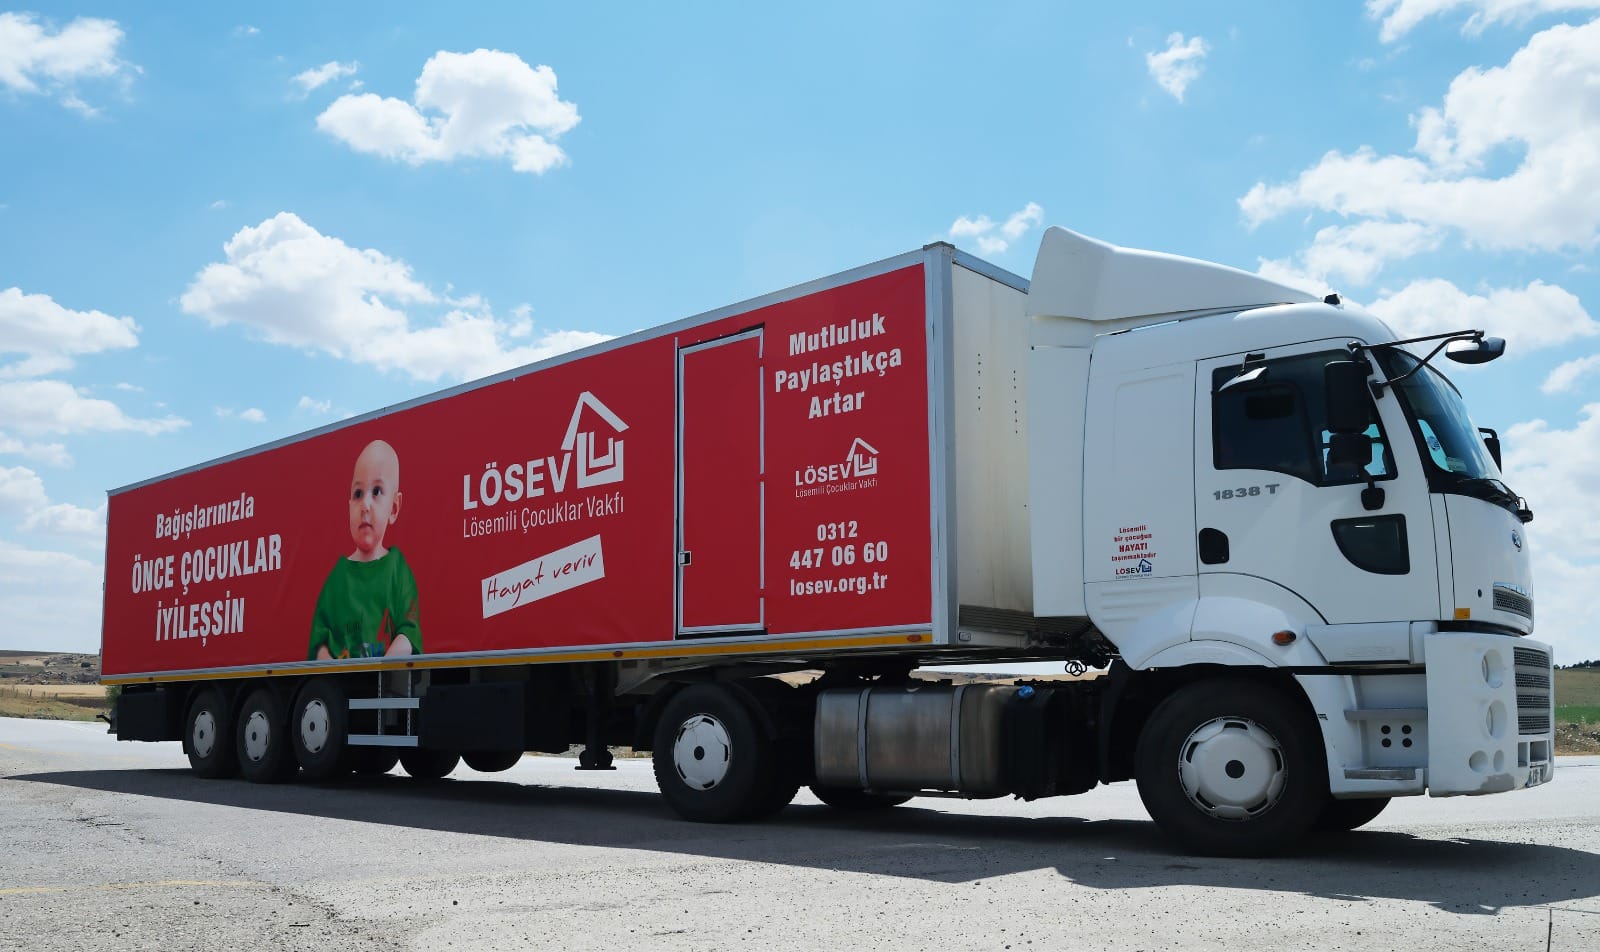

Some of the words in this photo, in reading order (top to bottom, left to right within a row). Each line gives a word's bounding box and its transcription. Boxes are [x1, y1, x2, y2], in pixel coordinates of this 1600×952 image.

[789, 313, 886, 356] Mutluluk
[775, 348, 902, 393] Paylaştıkça
[808, 390, 865, 419] Artar
[463, 452, 572, 510] LÖSEV
[795, 461, 852, 486] LÖSEV
[795, 486, 825, 498] Lösemili
[826, 482, 857, 496] Çocuklar
[858, 477, 878, 489] Vakfı
[1213, 486, 1261, 501] 1838
[1265, 483, 1280, 494] T
[155, 492, 255, 541] Bağışlarınızla
[463, 510, 517, 538] Lösemili
[521, 501, 584, 534] Çocuklar
[586, 491, 624, 518] Vakfı
[816, 520, 858, 542] 0312
[132, 553, 175, 594] ÖNCE
[180, 533, 282, 595] ÇOCUKLAR
[789, 547, 824, 570] 447
[831, 544, 856, 566] 06
[863, 541, 888, 563] 60
[1119, 542, 1148, 553] HAYATI
[487, 561, 545, 607] Hayat
[553, 552, 597, 579] verir
[790, 572, 888, 596] losev.org.tr
[155, 590, 245, 647] İYİLEŞSİN
